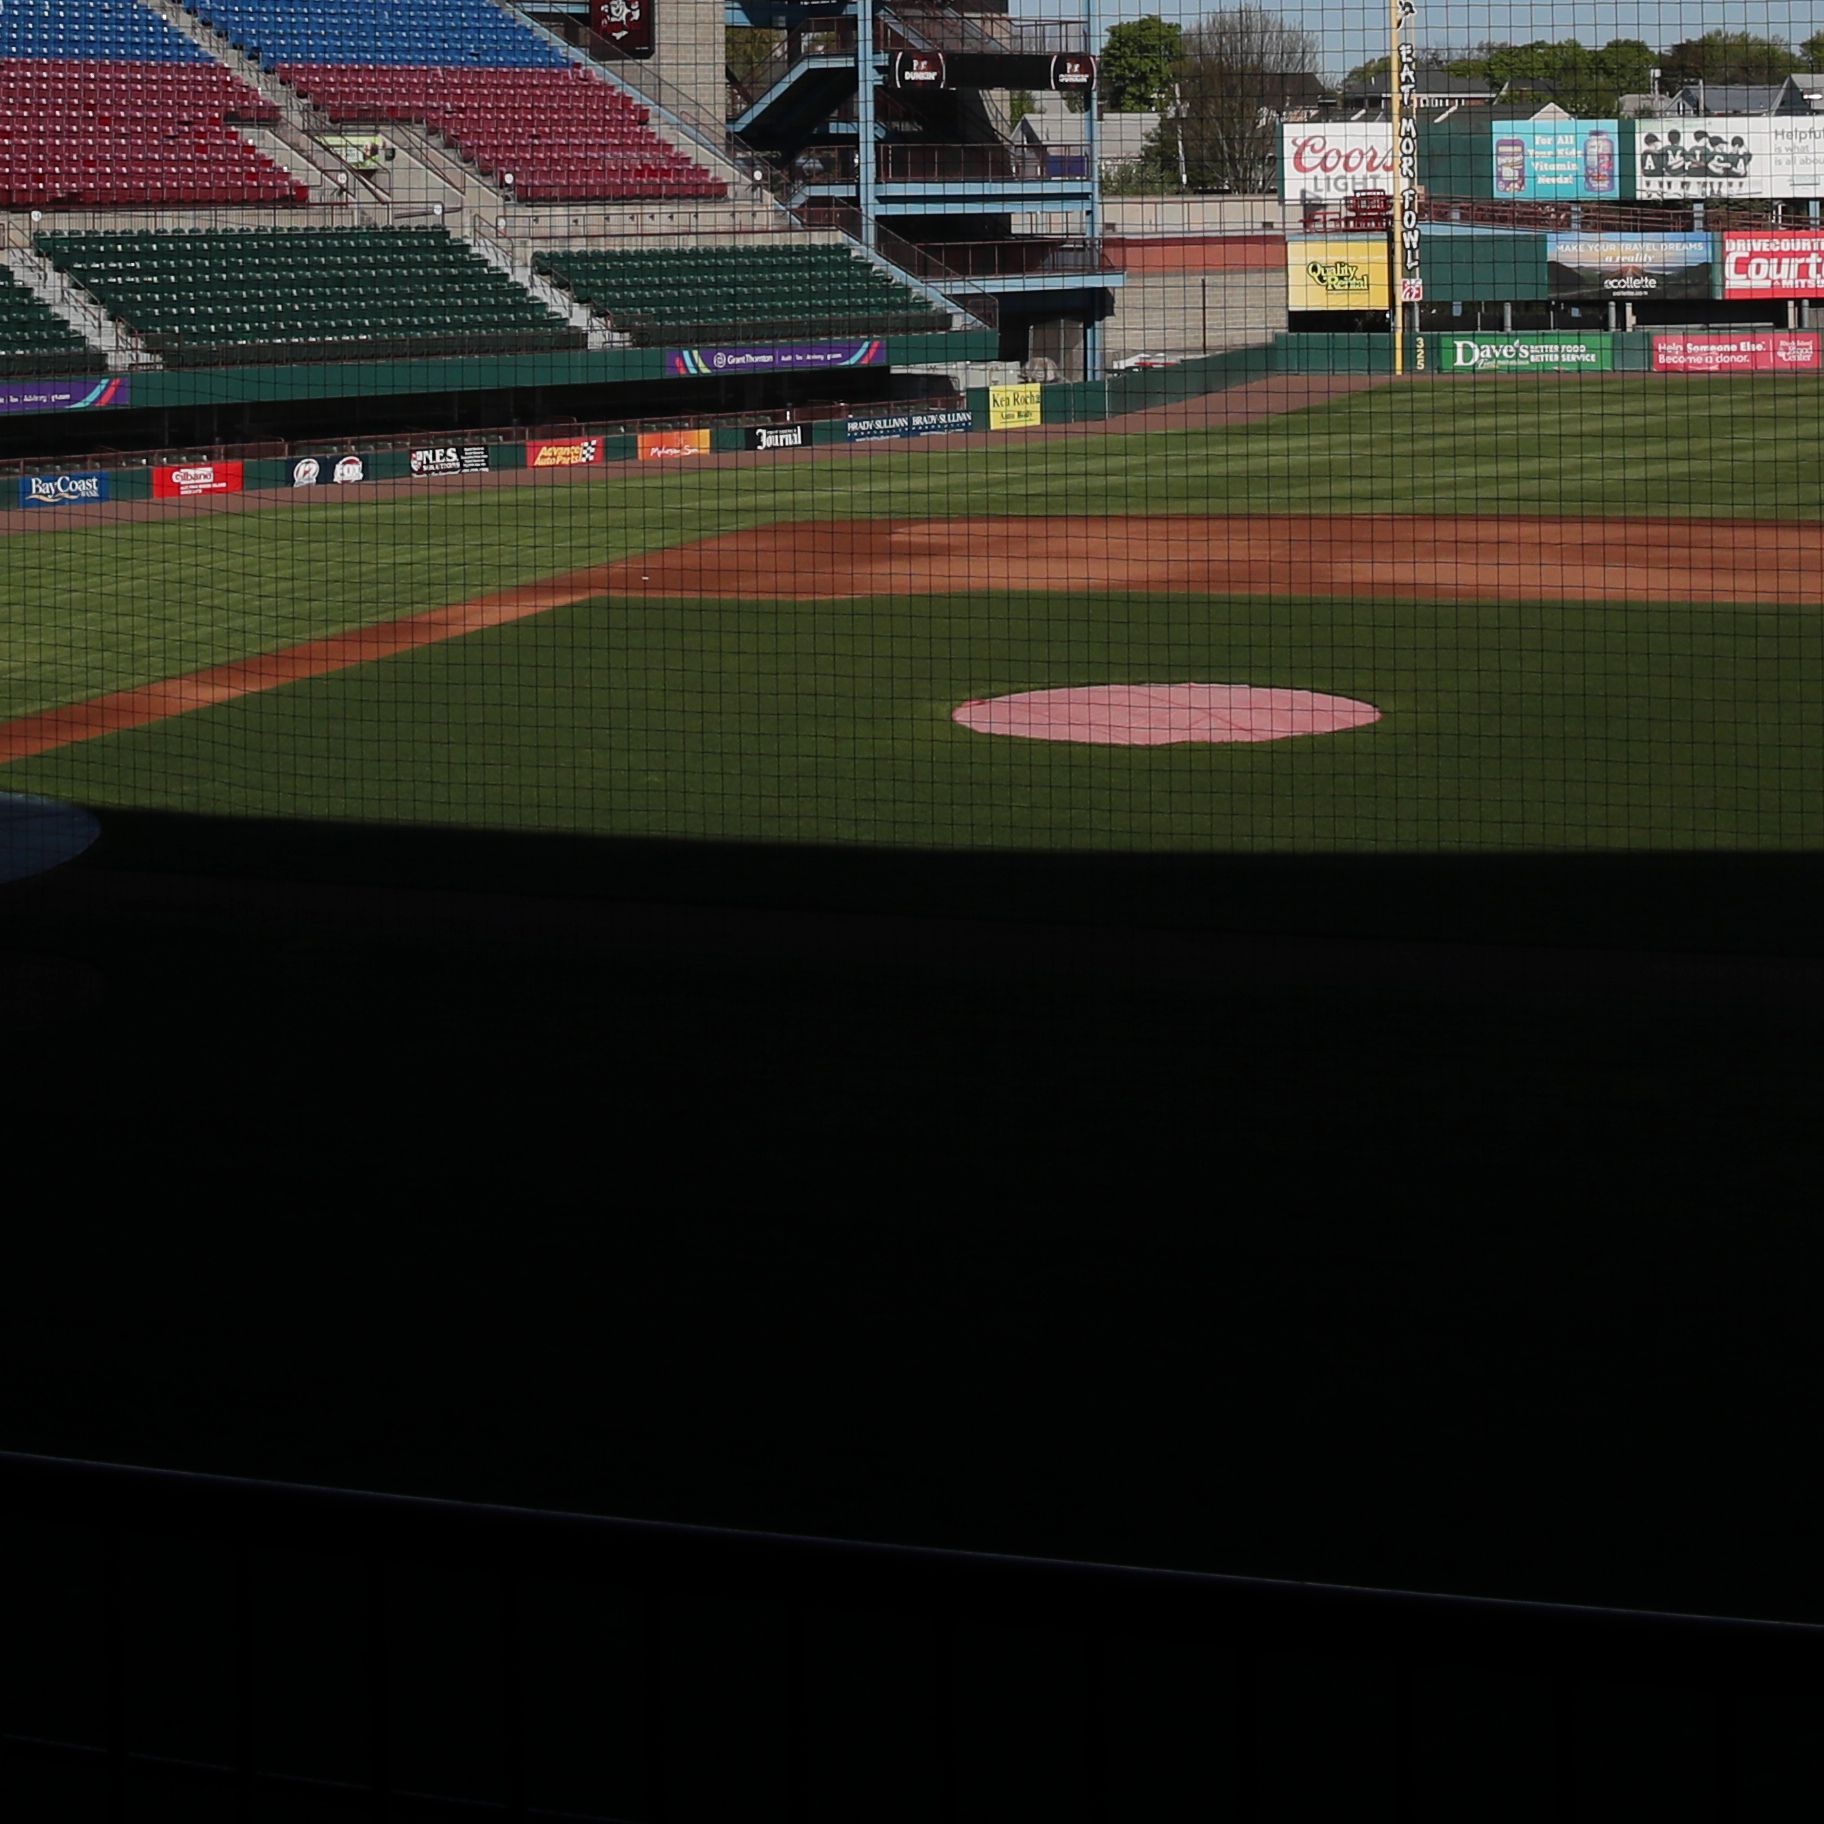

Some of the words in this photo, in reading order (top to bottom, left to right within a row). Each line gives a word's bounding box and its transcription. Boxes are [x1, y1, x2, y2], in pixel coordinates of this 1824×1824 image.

[1398, 42, 1416, 106] EAT
[1291, 134, 1395, 174] Coors
[1398, 118, 1417, 178] MOR
[1784, 144, 1810, 153] what
[1313, 174, 1382, 194] LIGHT
[1401, 189, 1419, 271] FOWL
[1556, 242, 1586, 253] MAKE
[1587, 242, 1619, 253] YOUR
[1620, 242, 1659, 253] TRAVEL
[1660, 241, 1705, 252] DREAMS
[1307, 261, 1359, 286] Quality
[1325, 272, 1369, 291] Rental
[1415, 336, 1426, 371] 325
[1453, 338, 1531, 367] Dave's
[1530, 344, 1560, 354] BETTER
[1561, 344, 1587, 354] FOOD
[1530, 354, 1560, 363] BETTER
[1561, 353, 1597, 363] SERVICE
[1657, 342, 1684, 355] Help
[1686, 342, 1738, 353] Someone
[1782, 353, 1812, 363] Center
[1657, 353, 1704, 364] Become
[1705, 355, 1714, 364] a
[1715, 353, 1750, 364] donor.
[992, 392, 1010, 408] Ken
[755, 425, 802, 450] Journal
[533, 456, 555, 466] Auto
[555, 454, 581, 465] Parts
[539, 445, 582, 457] Advance
[31, 475, 99, 498] BayCoast
